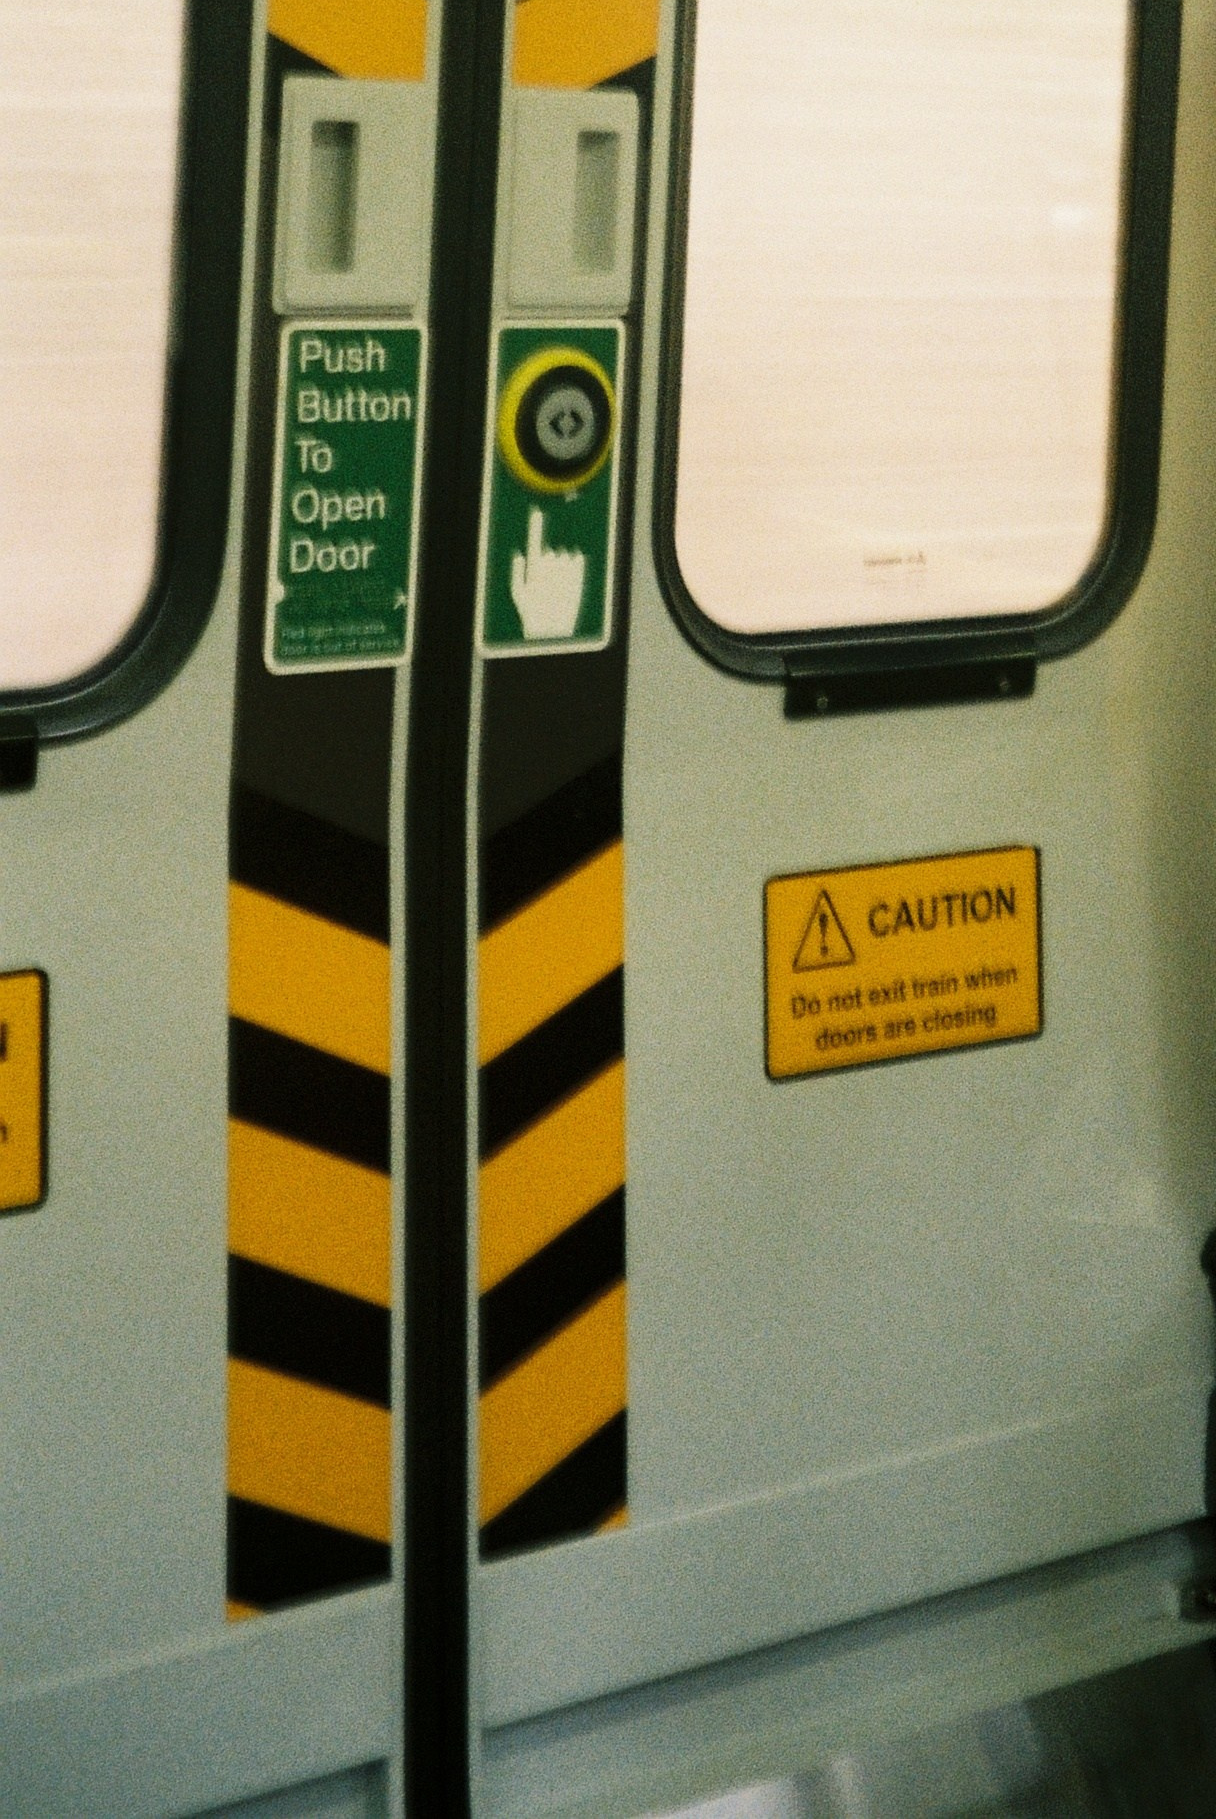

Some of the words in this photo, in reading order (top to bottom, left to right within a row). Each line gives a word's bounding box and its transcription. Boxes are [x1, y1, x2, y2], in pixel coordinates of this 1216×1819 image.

[299, 337, 387, 373] Push
[297, 388, 412, 424] Button
[295, 437, 334, 474] To
[291, 489, 386, 532] Open
[289, 537, 376, 574] Door
[868, 885, 1017, 938] CAUTION
[791, 996, 821, 1020] Do
[828, 989, 862, 1013] not
[868, 980, 905, 1004] exit
[912, 972, 959, 998] train
[964, 966, 1018, 991] when
[815, 1023, 878, 1051] doors
[883, 1018, 916, 1039] are
[921, 1003, 997, 1032] closing
